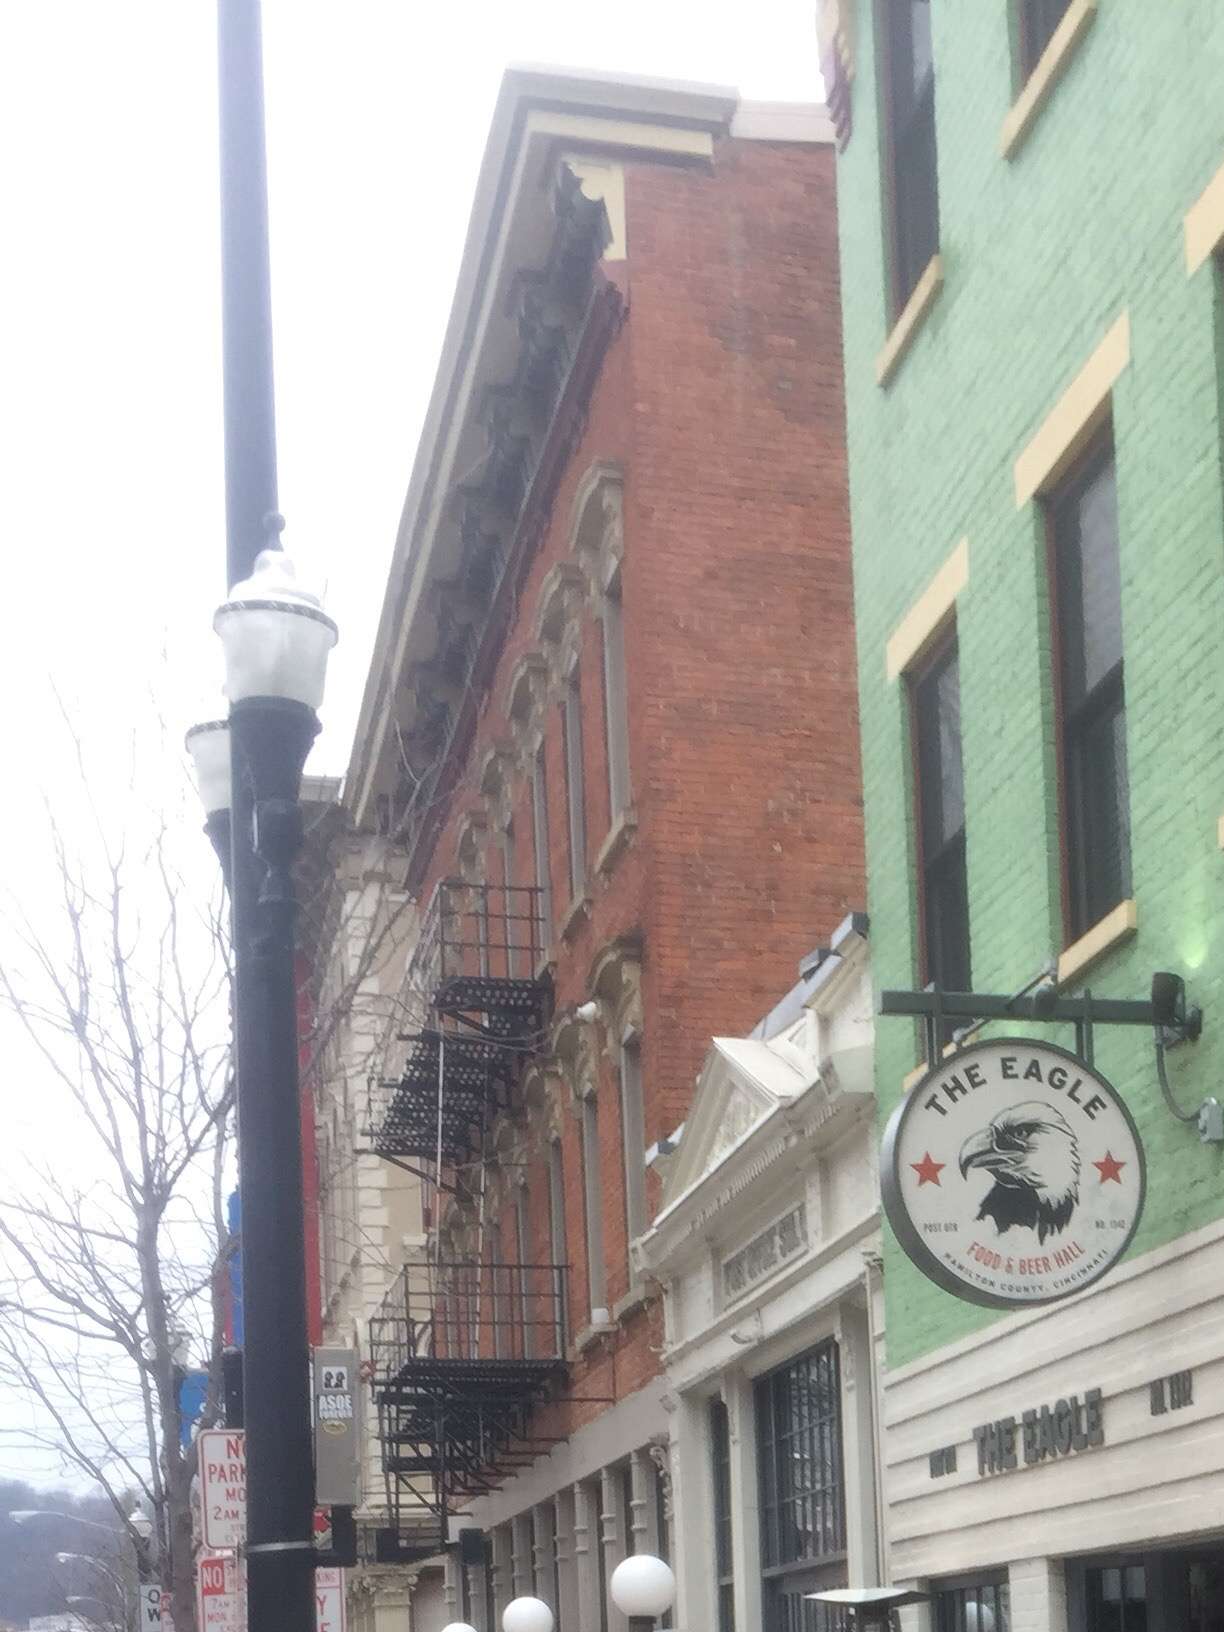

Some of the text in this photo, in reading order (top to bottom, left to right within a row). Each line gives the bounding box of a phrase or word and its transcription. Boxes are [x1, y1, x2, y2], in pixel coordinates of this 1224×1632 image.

[925, 1056, 1107, 1121] THE EAGLE
[944, 1252, 995, 1288] HAMILTON
[1053, 1249, 1109, 1289] CINCINNATI
[966, 1240, 1085, 1275] FOOD & BEER HALL
[973, 1416, 1017, 1477] THE
[1022, 1387, 1104, 1465] EAGLE
[202, 1566, 224, 1589] NO
